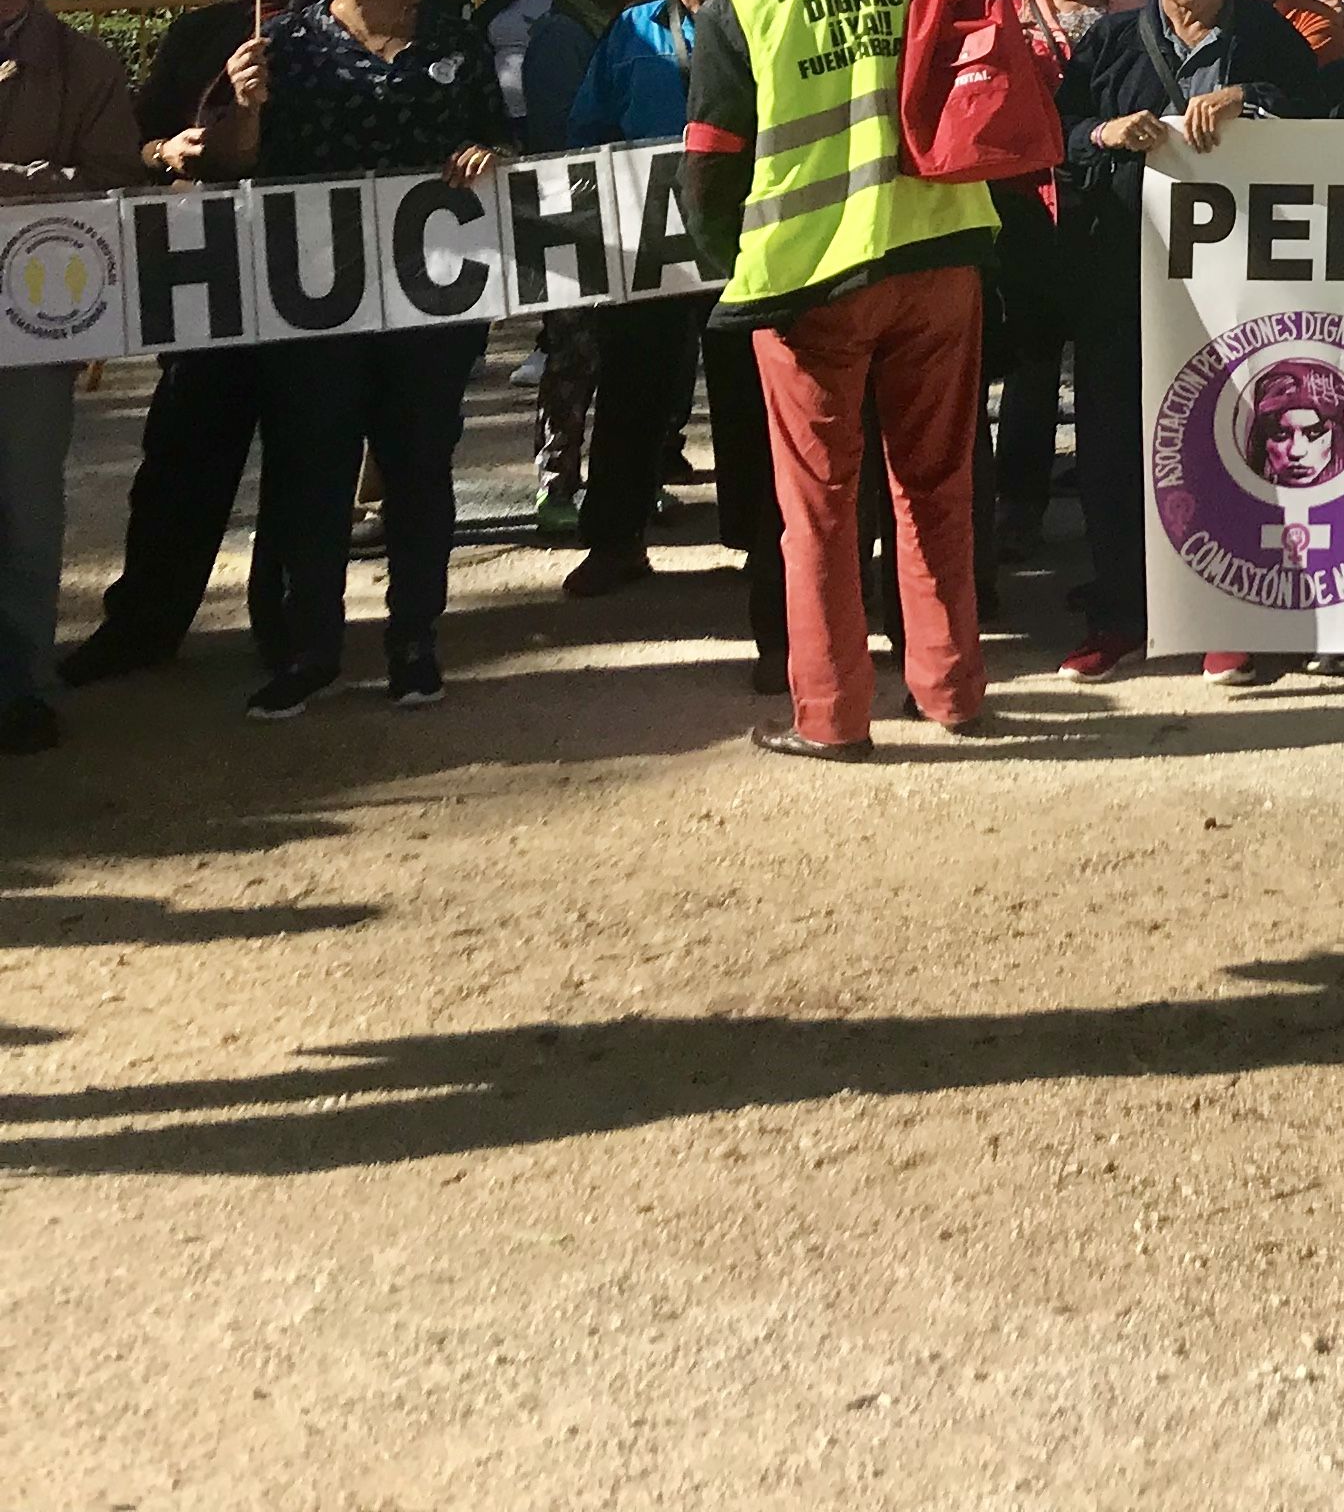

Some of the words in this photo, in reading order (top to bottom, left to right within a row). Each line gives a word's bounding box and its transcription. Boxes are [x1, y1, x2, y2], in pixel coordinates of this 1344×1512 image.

[797, 36, 900, 79] FUENLABRA
[133, 150, 728, 346] HUCHA
[1192, 312, 1297, 382] PENSIONES
[1301, 569, 1334, 608] DE
